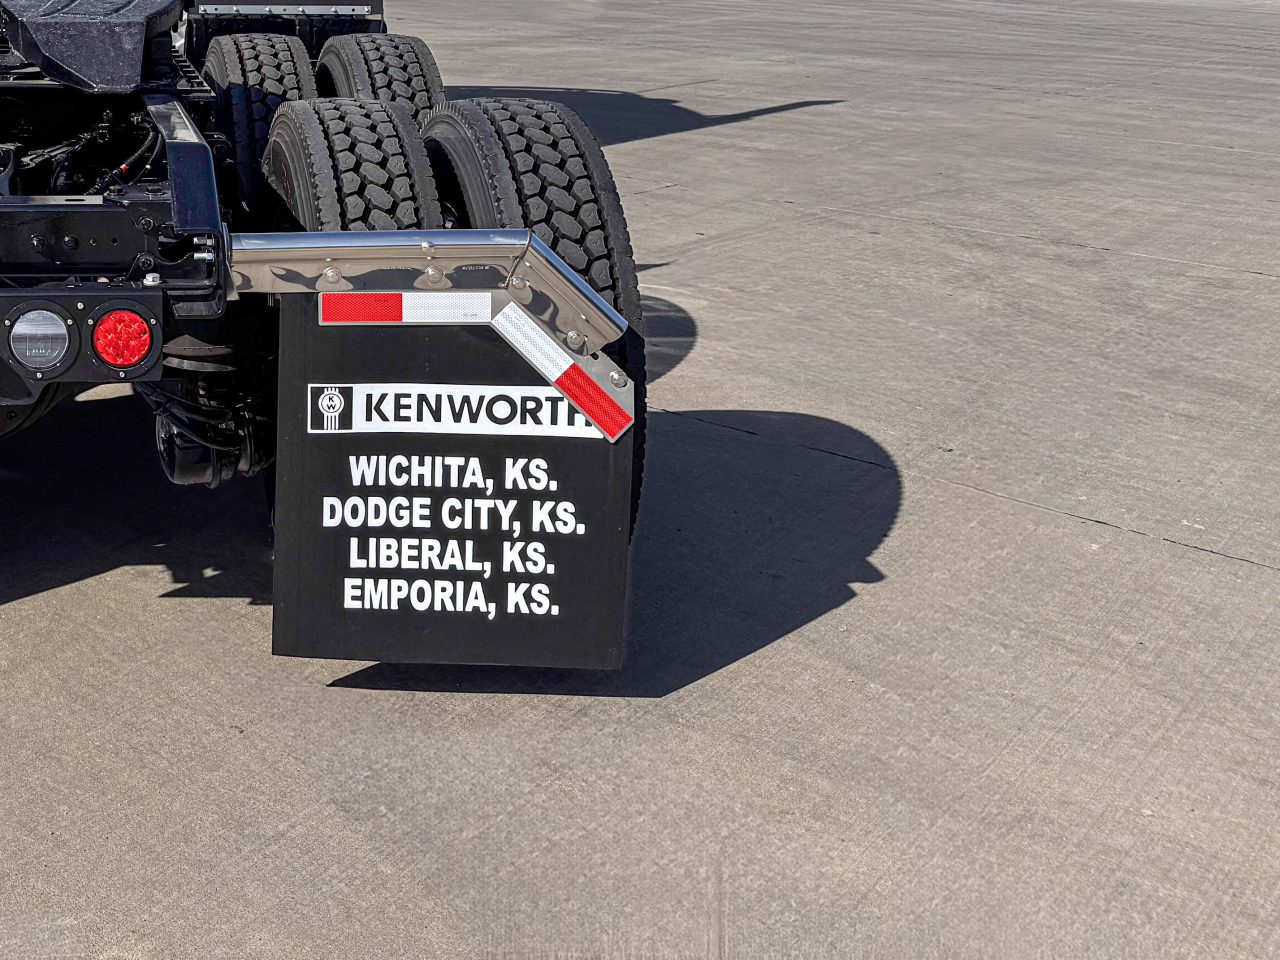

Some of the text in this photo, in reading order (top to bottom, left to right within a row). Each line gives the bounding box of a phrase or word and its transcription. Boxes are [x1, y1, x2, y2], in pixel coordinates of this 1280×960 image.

[349, 455, 558, 496] WICHITA, KS.
[322, 496, 586, 539] DODGE CITY, KS.
[349, 537, 556, 580] LIBERAL, KS.
[343, 577, 560, 621] EMPORIA, KS.
